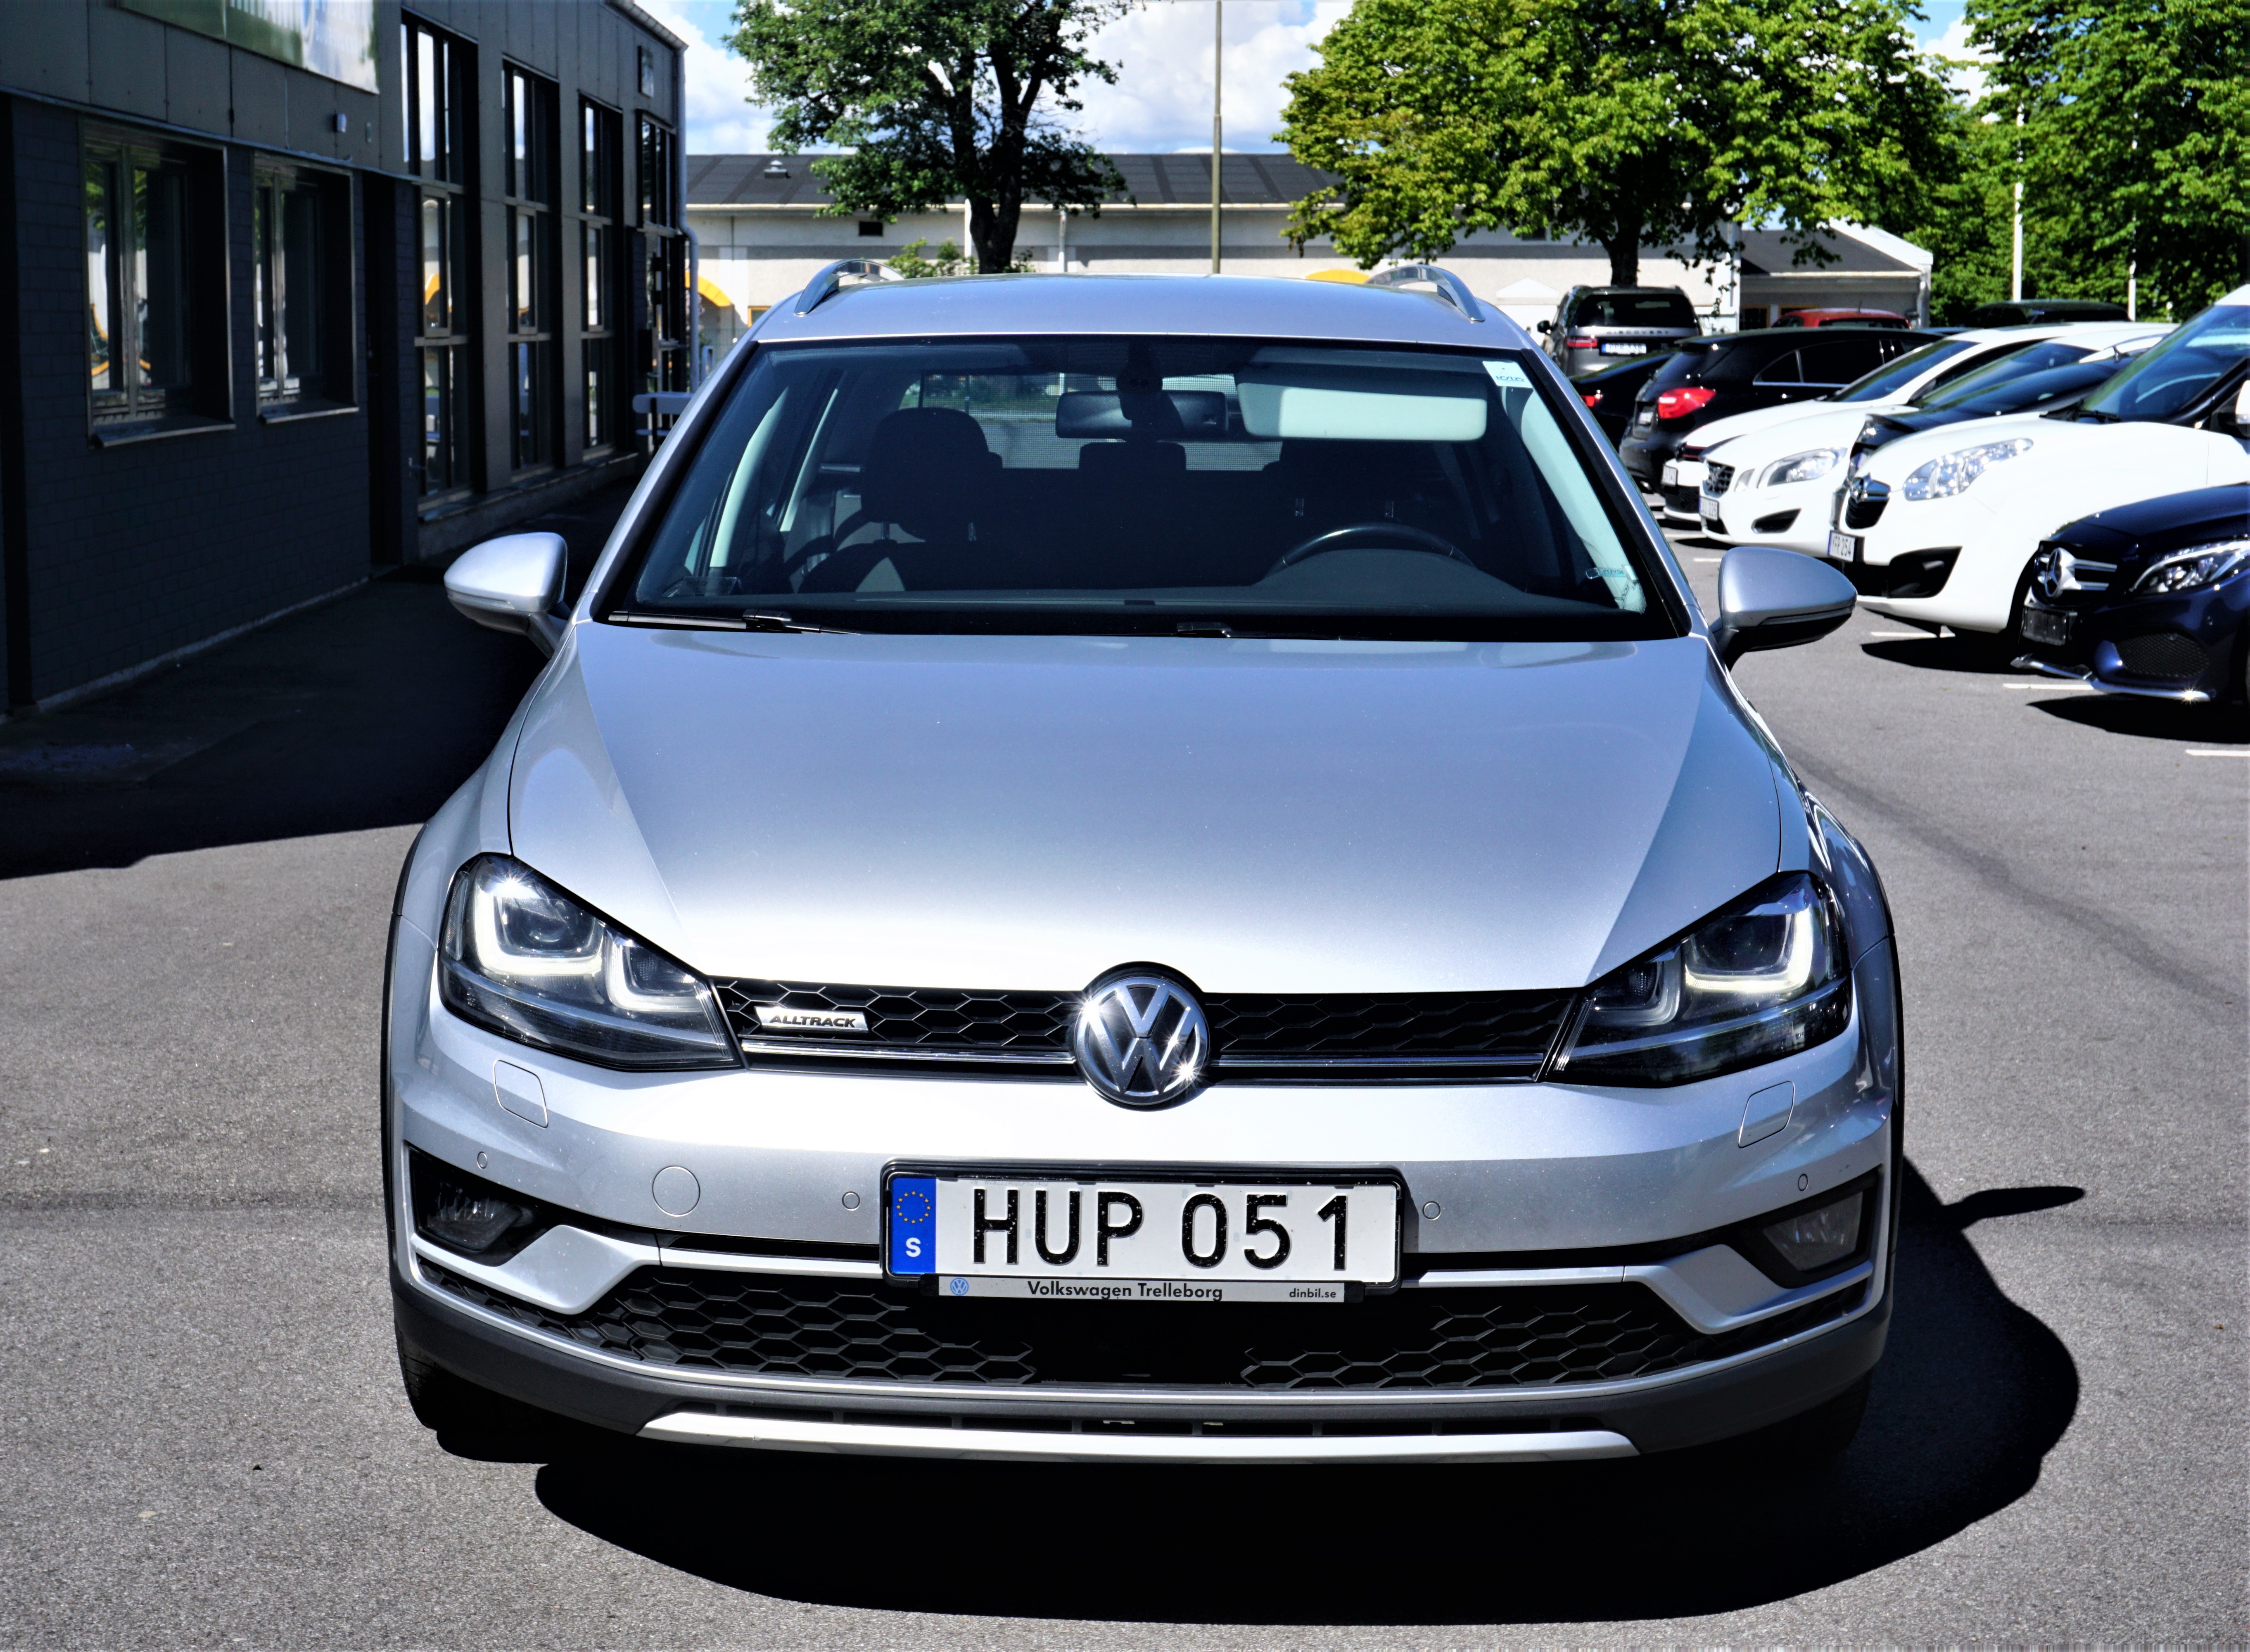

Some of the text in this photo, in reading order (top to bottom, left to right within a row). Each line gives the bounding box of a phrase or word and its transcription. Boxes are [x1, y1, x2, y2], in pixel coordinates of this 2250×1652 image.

[769, 1015, 856, 1028] ALLTRACK
[973, 1189, 1347, 1271] HUP 051
[906, 1237, 921, 1257] S
[1028, 1281, 1222, 1301] Volkswagen Trelleborg
[1289, 1288, 1336, 1298] dinbil.se
